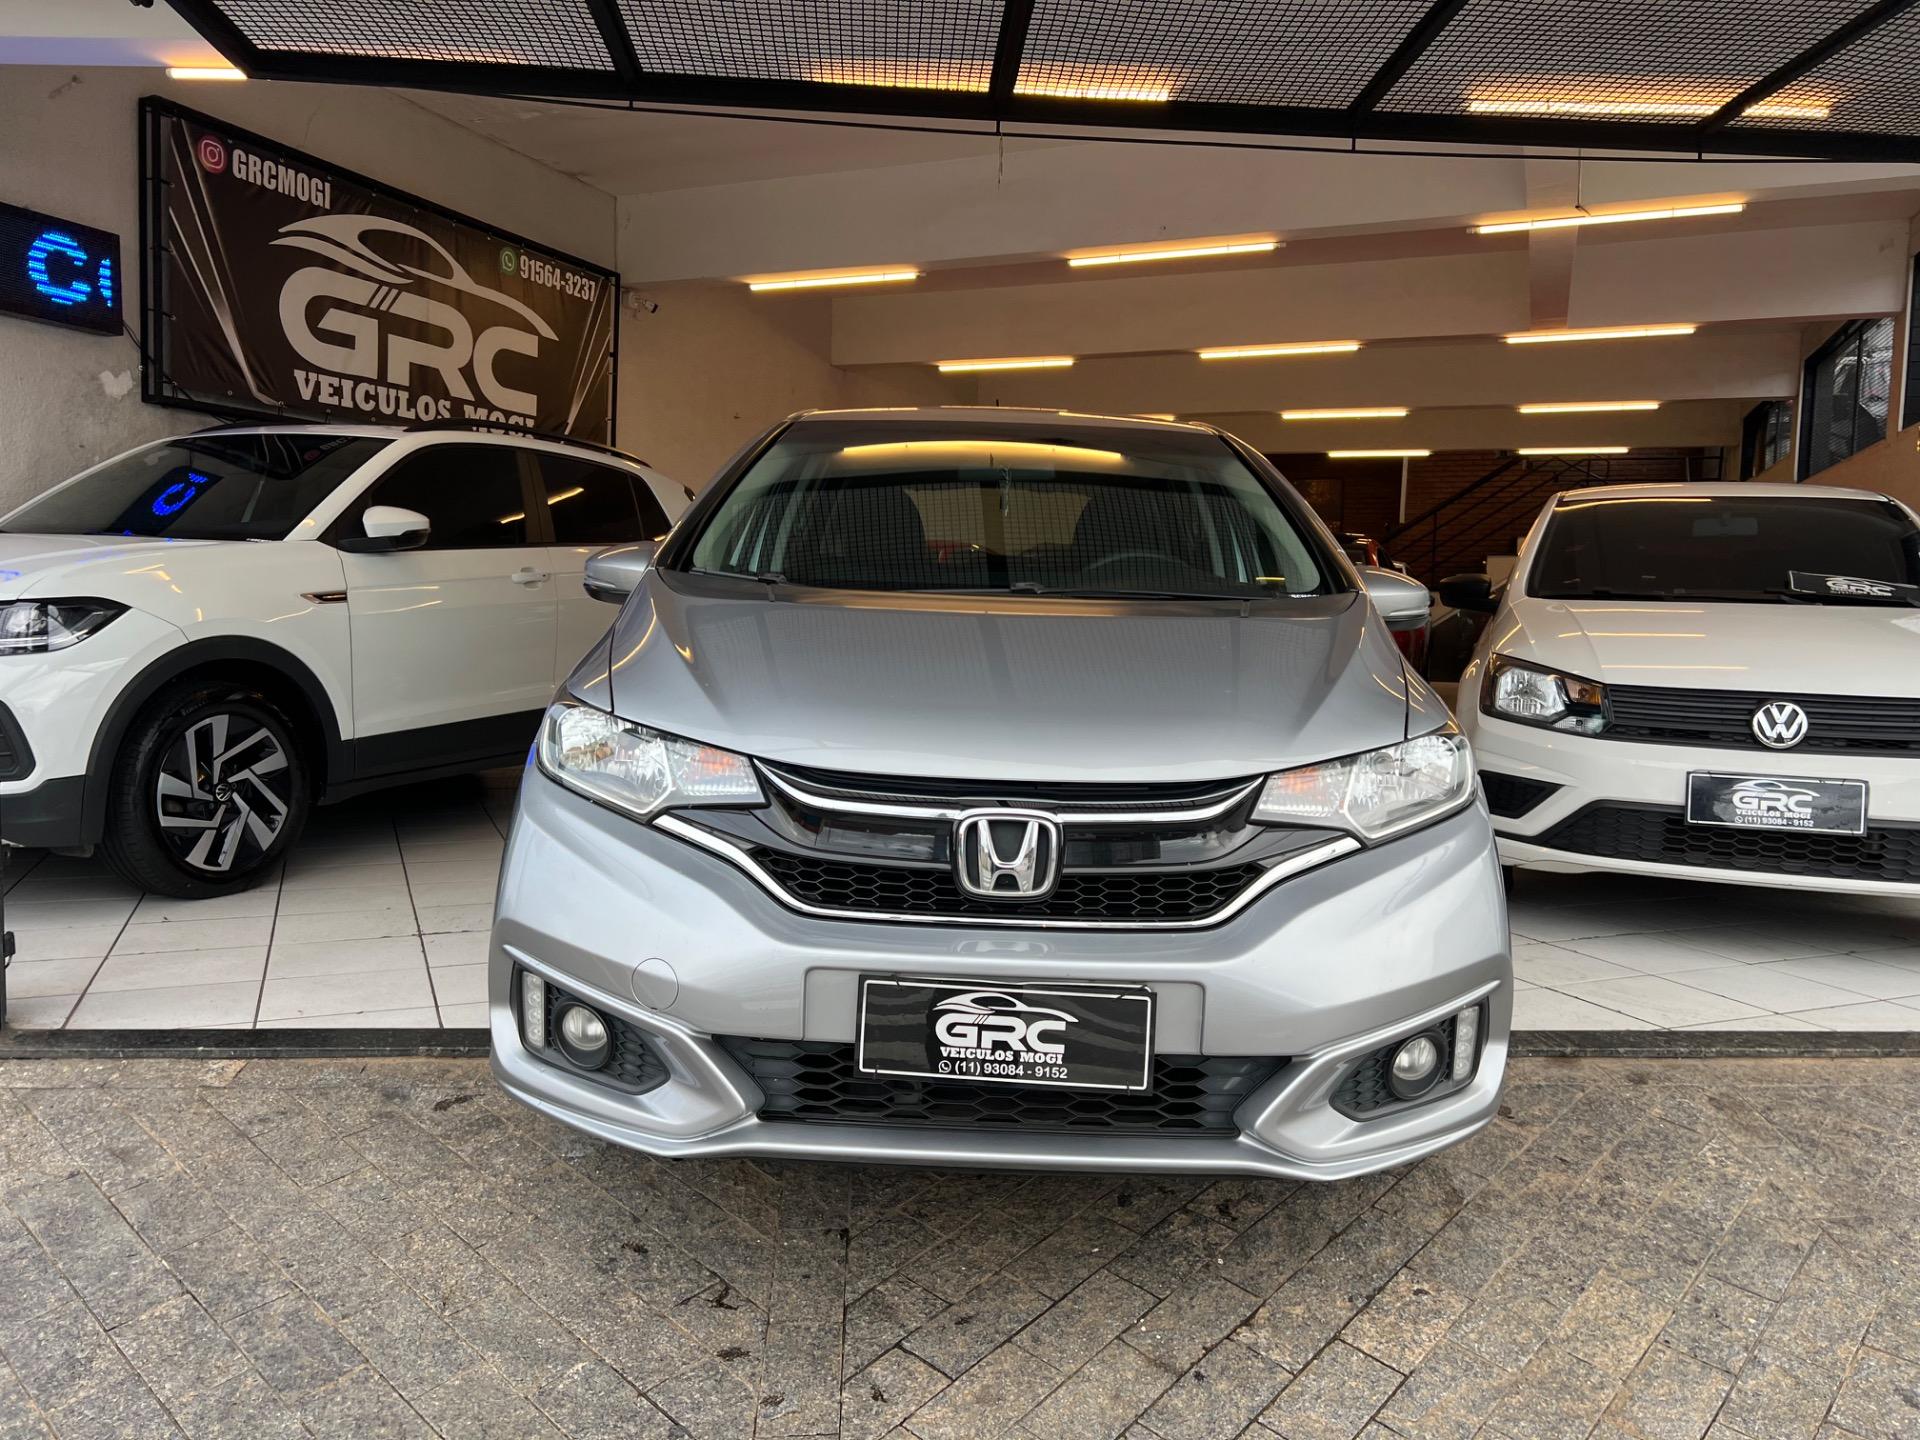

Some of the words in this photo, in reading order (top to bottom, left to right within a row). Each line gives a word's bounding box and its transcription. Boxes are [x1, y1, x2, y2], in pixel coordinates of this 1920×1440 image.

[232, 149, 331, 210] GRCMOGI
[520, 255, 596, 302] 91564-3237
[278, 266, 539, 416] GRC
[294, 369, 451, 422] VEICULOS
[1732, 790, 1813, 813] GRC
[1736, 808, 1780, 818] VEICULOS
[1784, 811, 1811, 819] MOGI
[935, 1012, 1066, 1054] GRC
[940, 1046, 1014, 1061] VEICULOS
[1019, 1051, 1063, 1065] MOGI
[955, 1060, 981, 1076] (11)
[983, 1062, 1025, 1077] 93084
[1034, 1065, 1068, 1079] 9152
